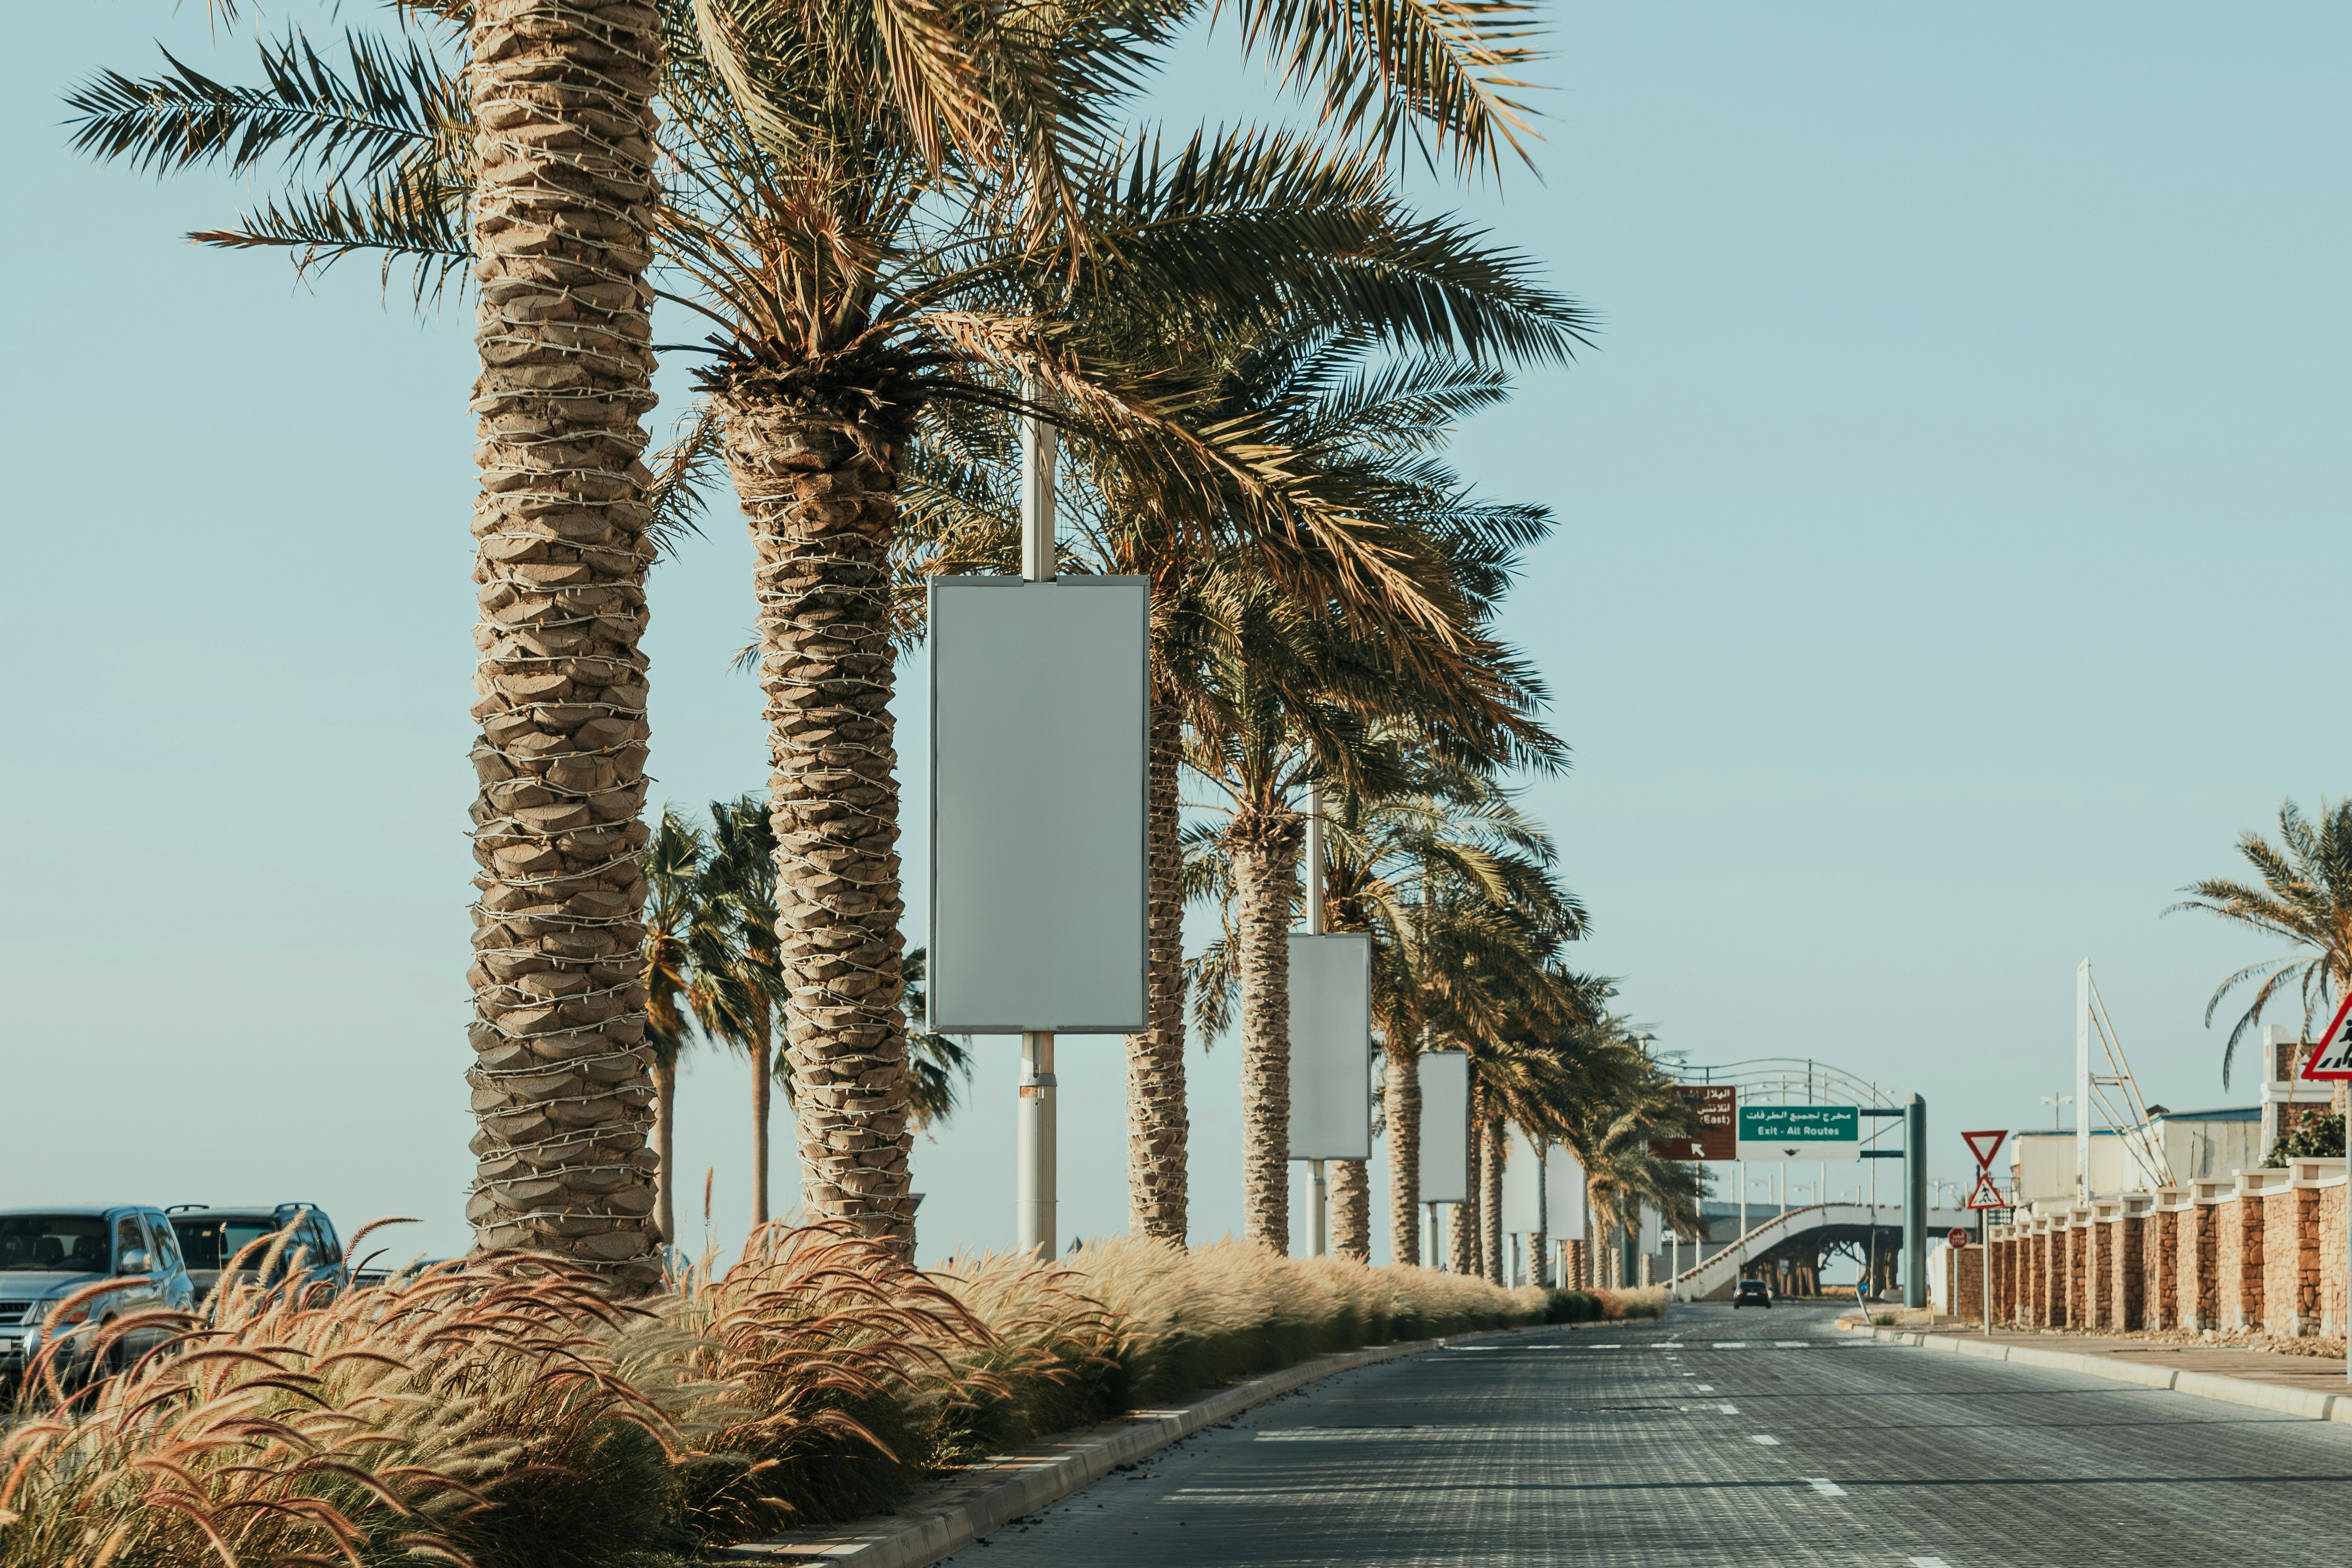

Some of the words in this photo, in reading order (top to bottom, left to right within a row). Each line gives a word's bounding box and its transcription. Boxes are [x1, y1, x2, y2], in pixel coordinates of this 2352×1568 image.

[1700, 1115, 1730, 1126] (East)
[1758, 1126, 1778, 1135] Exit
[1787, 1126, 1801, 1135] All
[1804, 1126, 1839, 1135] Routes
